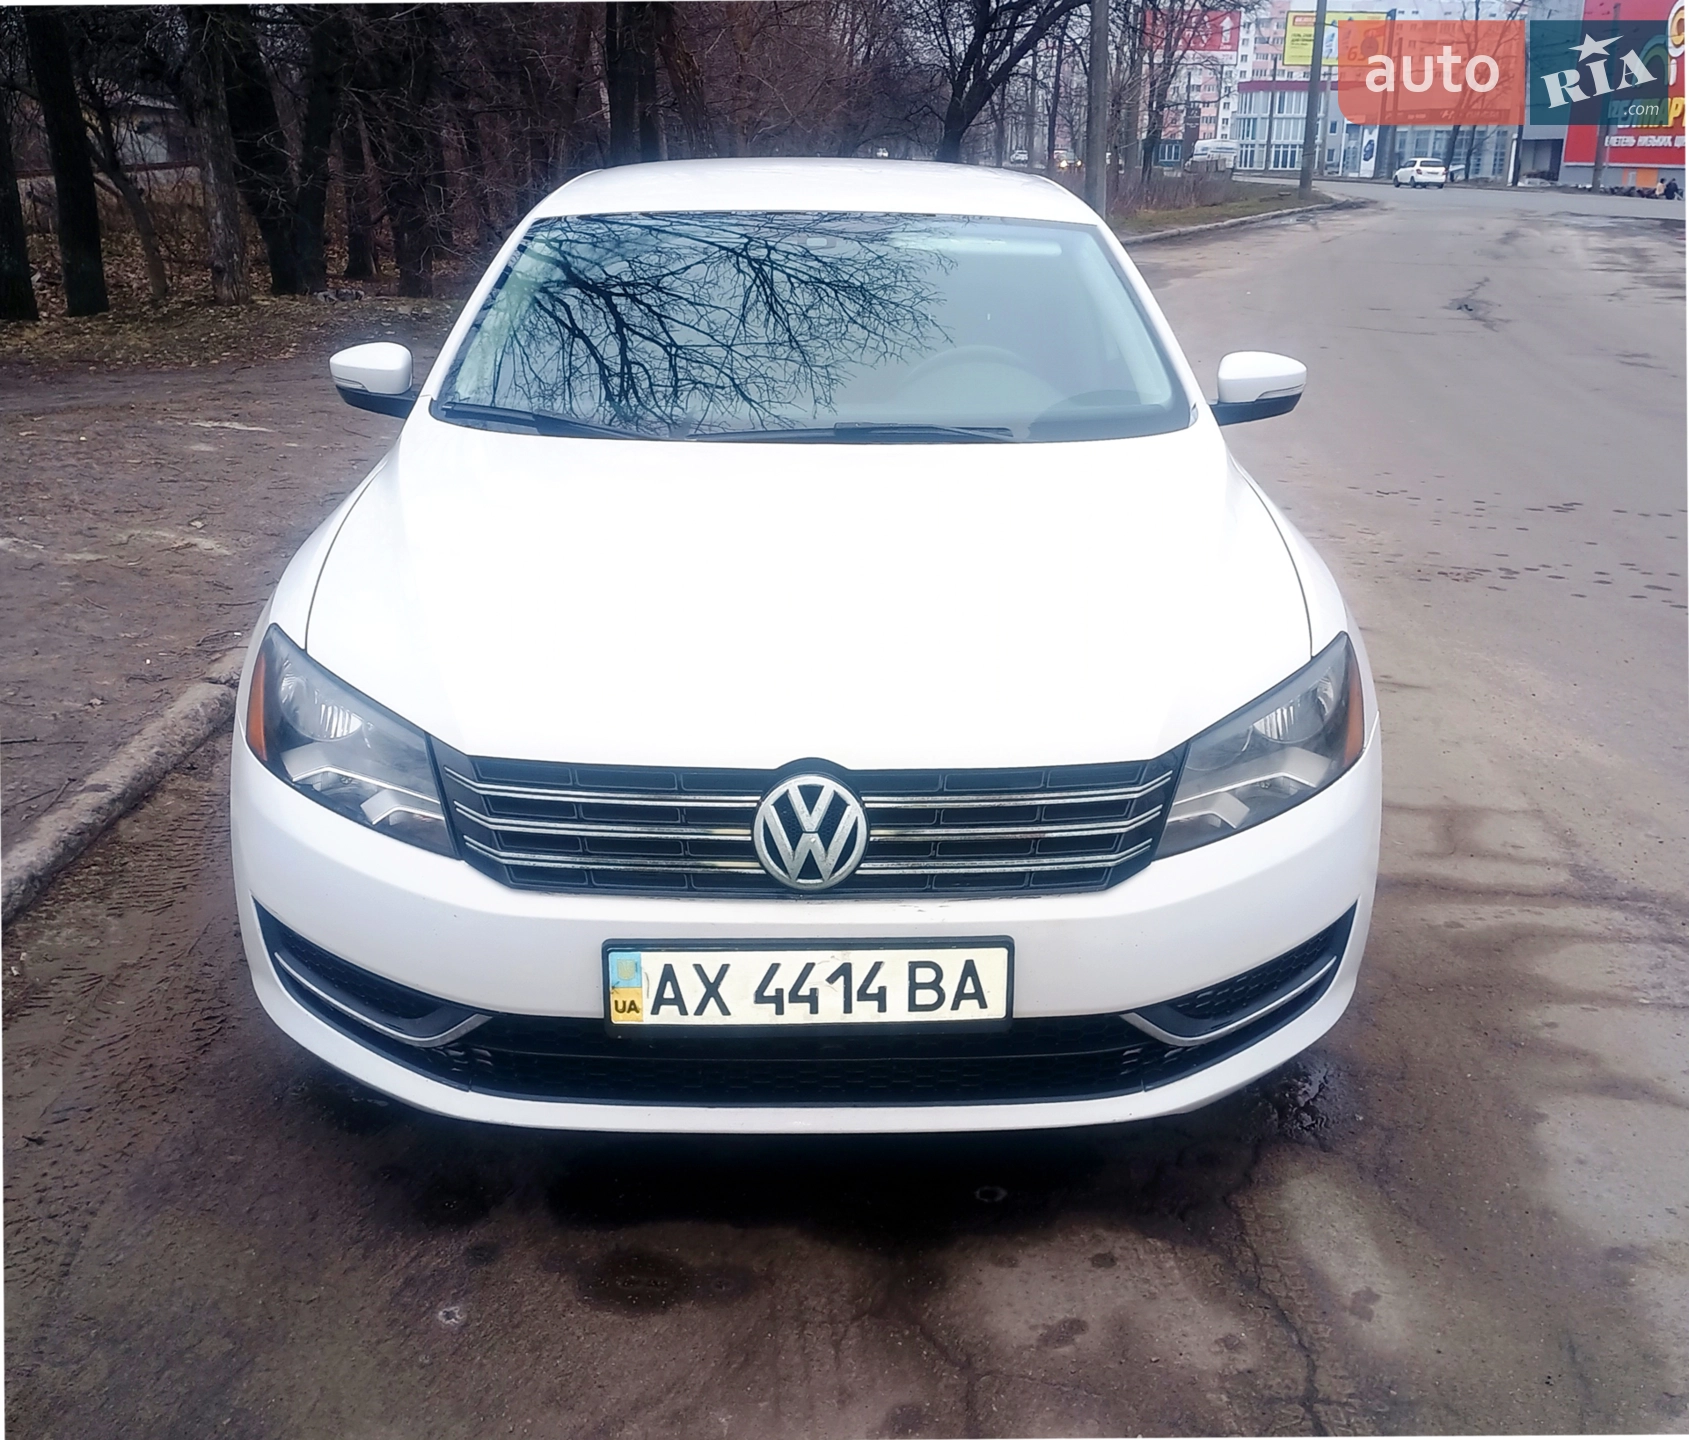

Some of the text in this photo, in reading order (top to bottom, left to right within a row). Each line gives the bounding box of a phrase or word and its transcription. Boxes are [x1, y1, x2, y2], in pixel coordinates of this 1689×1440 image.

[649, 958, 989, 1017] AX 4414 BA
[613, 1000, 641, 1014] UA
